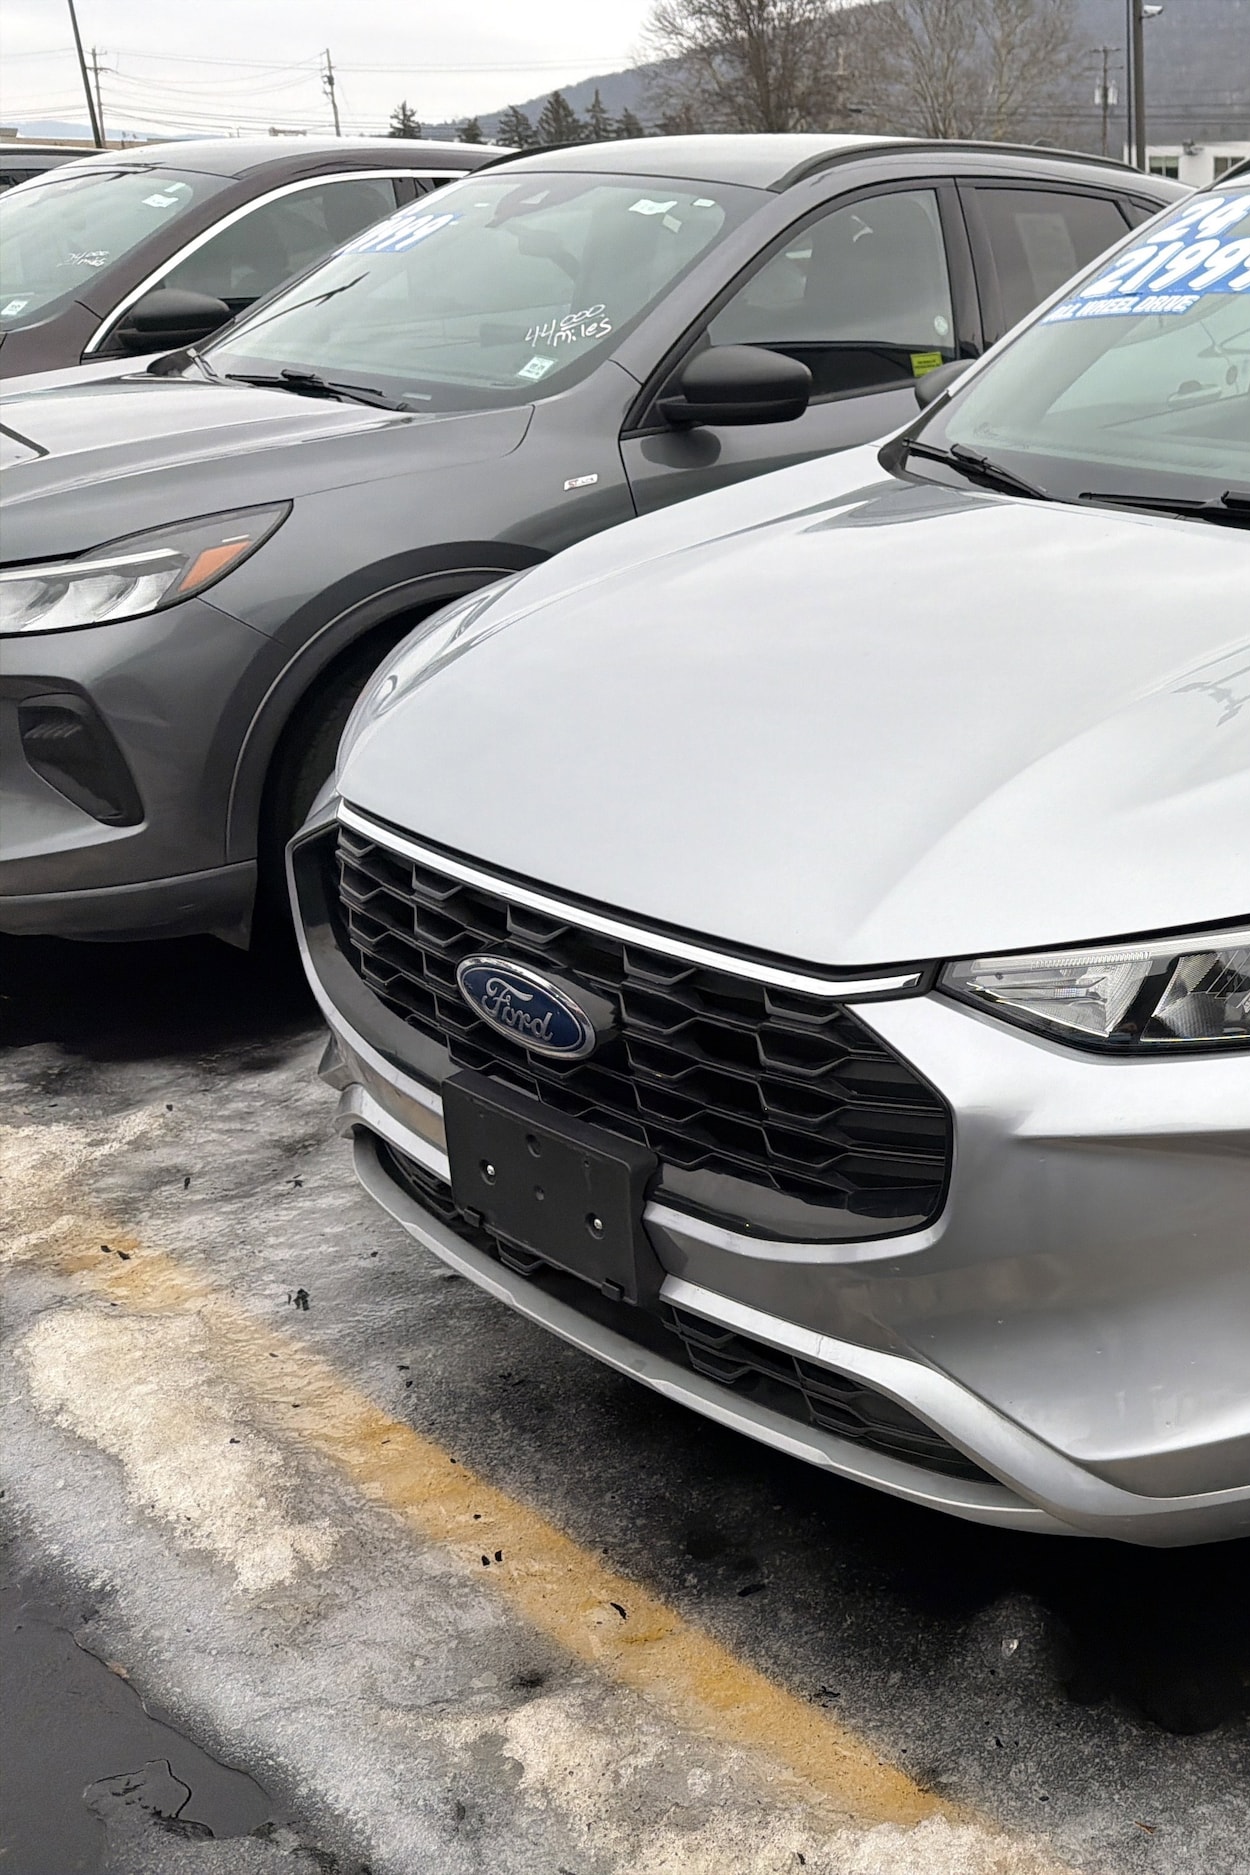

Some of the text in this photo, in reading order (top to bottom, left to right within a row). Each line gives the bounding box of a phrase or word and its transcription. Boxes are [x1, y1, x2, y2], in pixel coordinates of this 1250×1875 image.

[1075, 297, 1140, 317] WHEEL
[1132, 295, 1201, 313] DRIVE
[481, 976, 554, 1042] Ford
